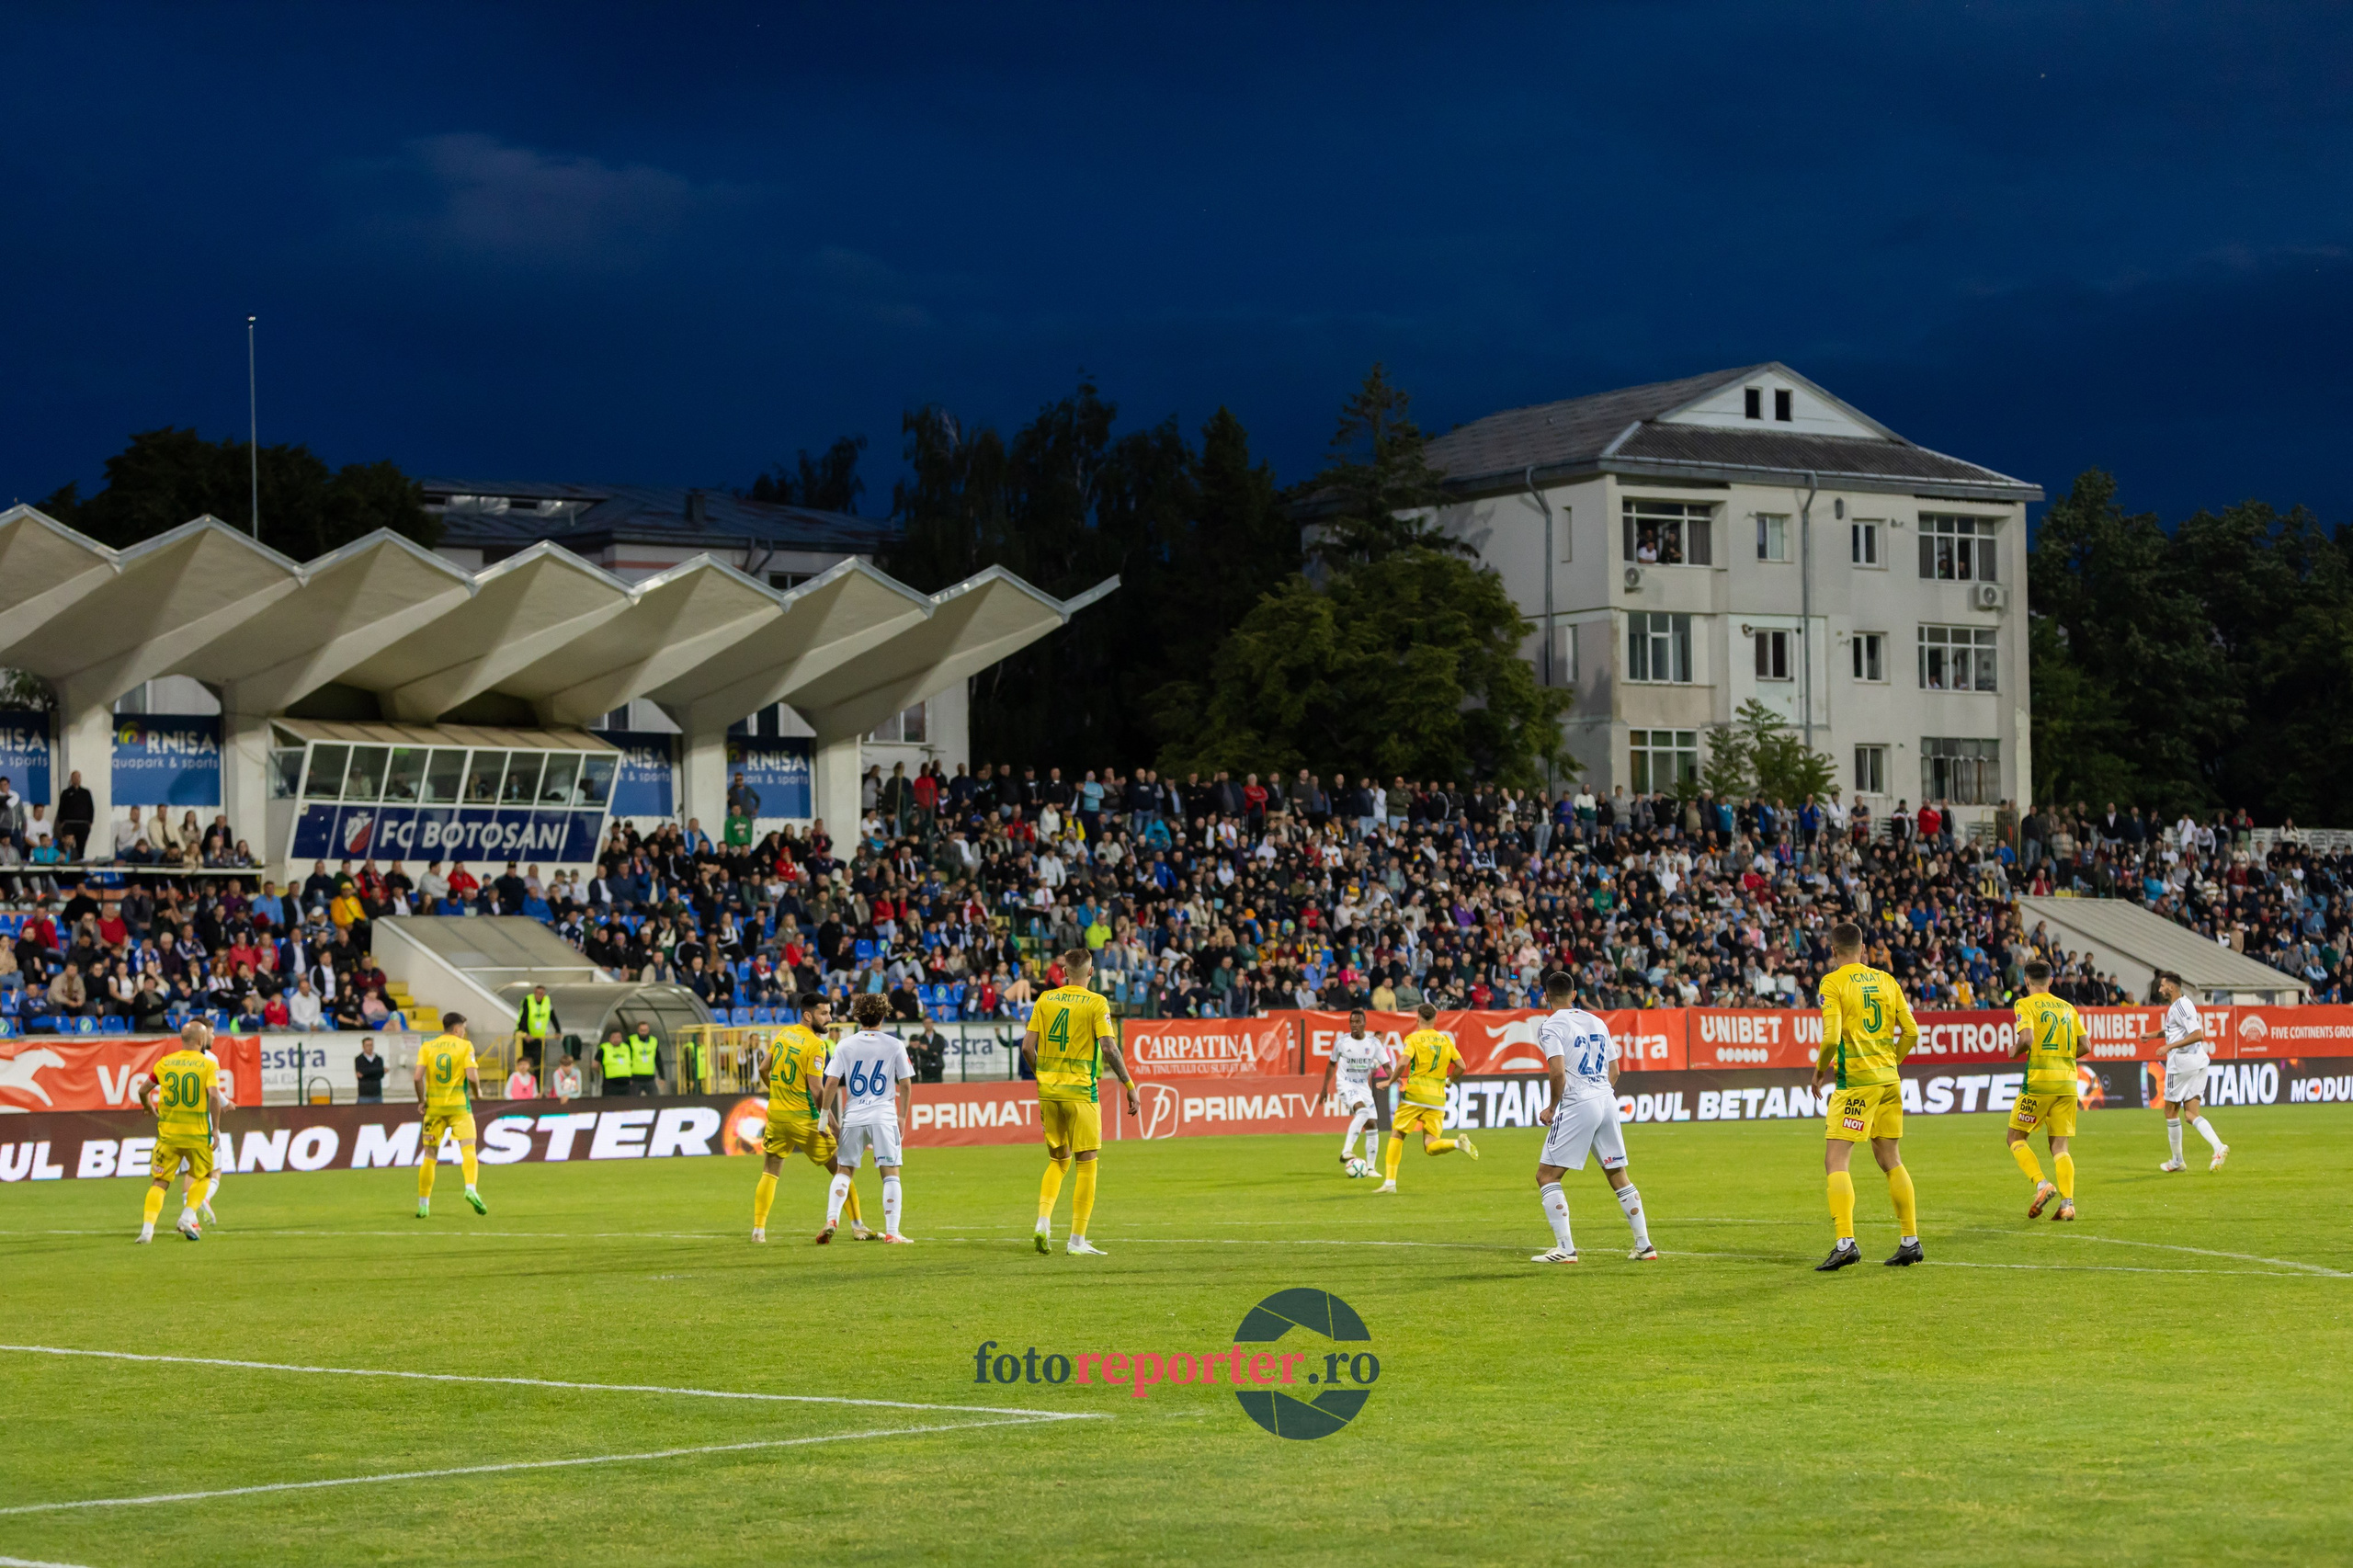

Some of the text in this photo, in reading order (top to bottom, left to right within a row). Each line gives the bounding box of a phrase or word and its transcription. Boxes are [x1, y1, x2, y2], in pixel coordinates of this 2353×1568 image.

[112, 756, 165, 769] quapark
[380, 820, 416, 847] FC
[1849, 972, 1881, 983] IGNAT
[1047, 993, 1091, 1005] GARUTTI
[1861, 985, 1882, 1034] 5
[1048, 1007, 1070, 1052] 4
[1701, 1015, 1782, 1044] UNIBET
[2040, 1010, 2072, 1051] 21
[2271, 1026, 2289, 1040] FIVE
[2290, 1026, 2335, 1040] CONTINENTS
[260, 1047, 325, 1069] estra
[1133, 1032, 1257, 1064] CARPATINA
[1429, 1044, 1442, 1073] 7
[1574, 1034, 1606, 1075] 27
[436, 1053, 451, 1084] 9
[770, 1041, 801, 1085] 25
[164, 1072, 199, 1108] 30
[849, 1060, 887, 1097] 66
[2290, 1075, 2353, 1102] MODU
[1442, 1079, 1560, 1130] BETAN
[1617, 1091, 1691, 1123] ODUL
[1846, 1098, 1866, 1108] APA
[1900, 1073, 2025, 1114] ASTE
[2020, 1103, 2033, 1113] DIN
[2021, 1097, 2037, 1107] APA
[912, 1099, 1039, 1131] PRIMAT
[1843, 1118, 1864, 1131] NOY
[1844, 1107, 1861, 1115] DIN
[2018, 1113, 2036, 1122] NOY
